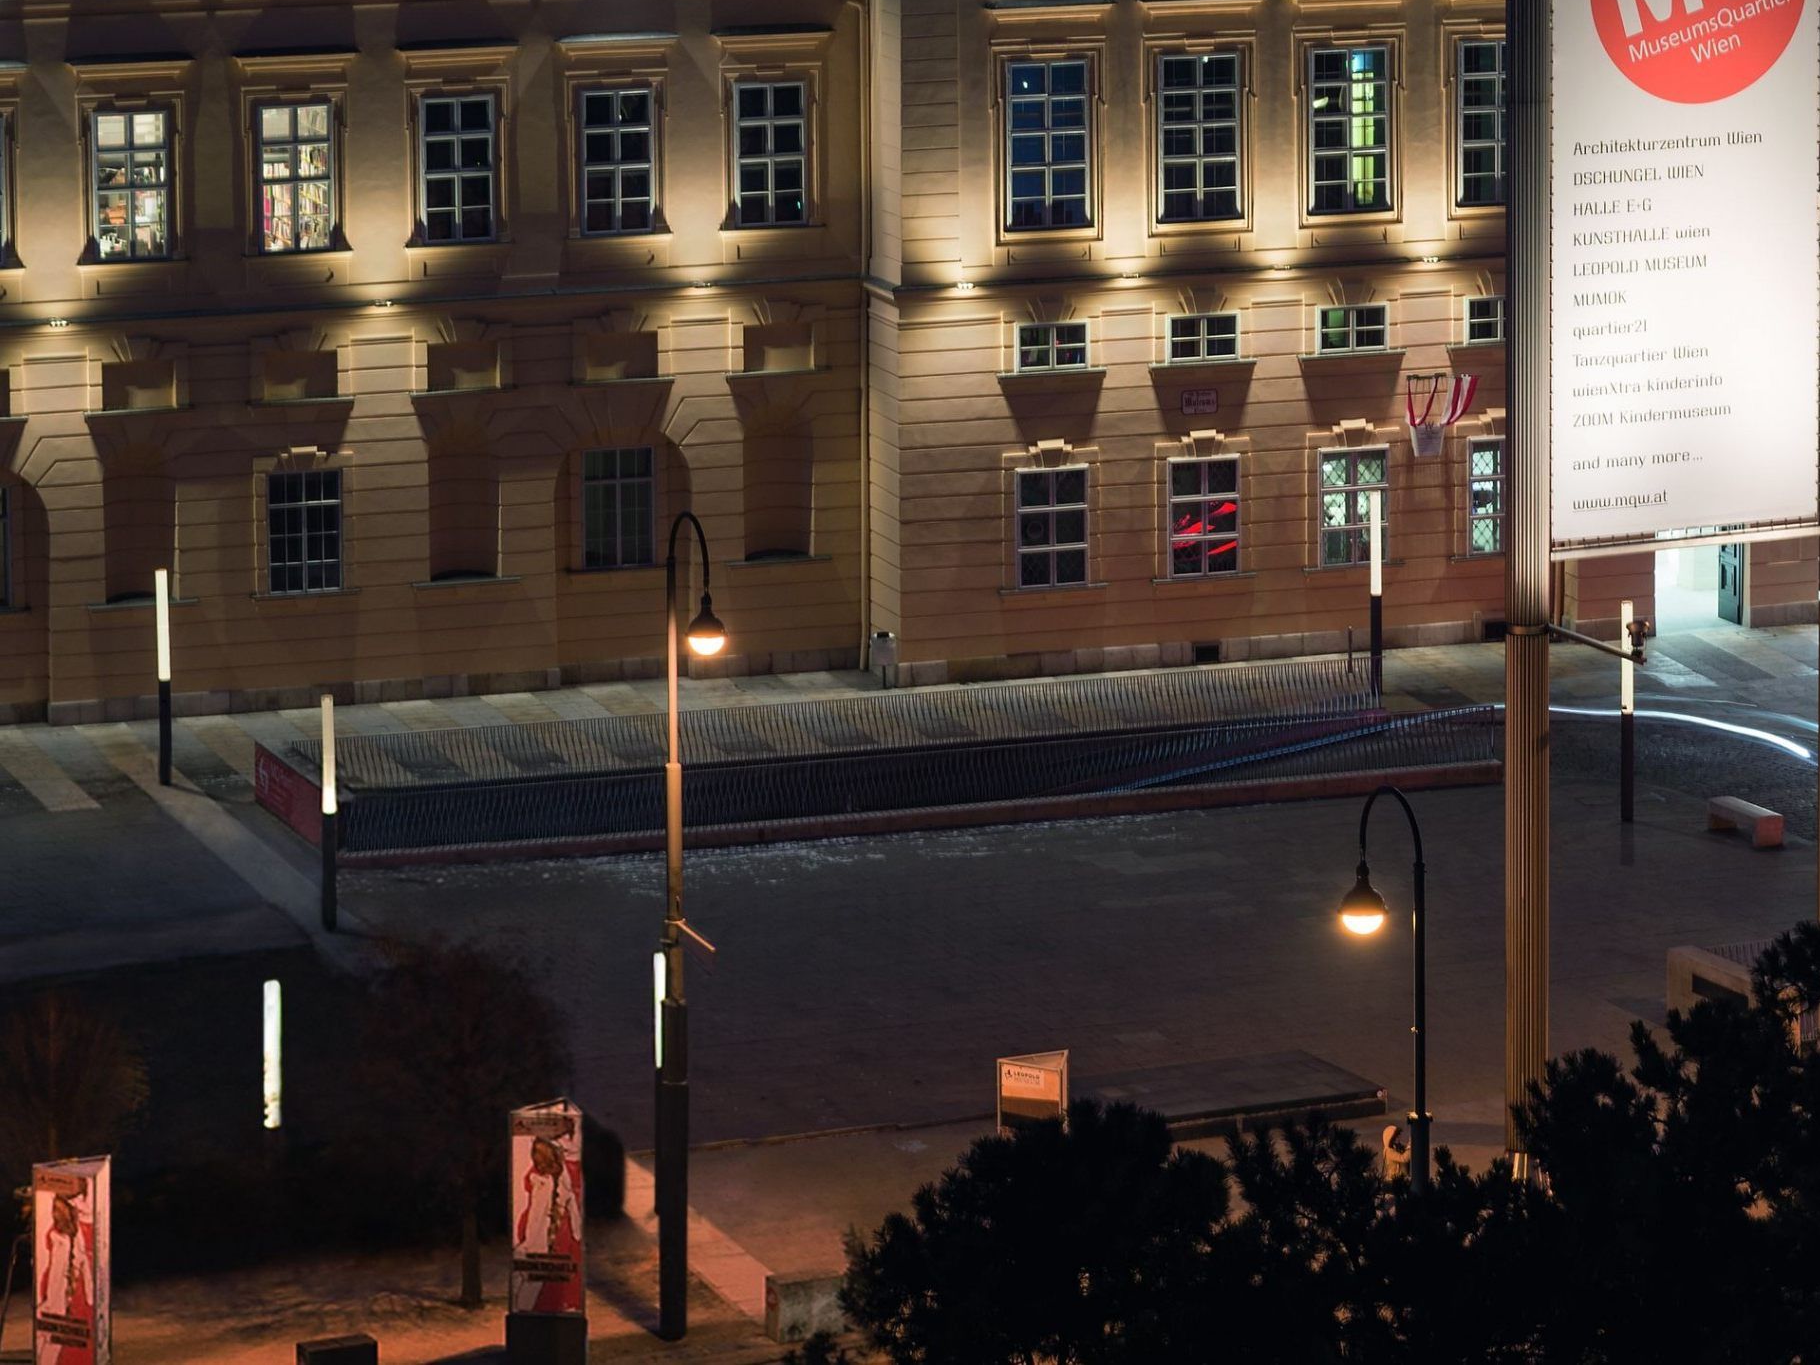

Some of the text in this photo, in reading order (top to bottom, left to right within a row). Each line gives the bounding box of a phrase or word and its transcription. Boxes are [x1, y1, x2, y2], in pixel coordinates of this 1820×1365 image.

[1690, 32, 1742, 65] Wien
[1573, 130, 1763, 156] Architekturzentrum Wien
[1573, 164, 1704, 186] DSCHUNGEL WIEN
[1573, 198, 1652, 217] HALLE E+G
[1573, 225, 1711, 247] KUNSTHALLE wien
[1573, 254, 1707, 277] LEOPOLD MUSEUM
[1573, 290, 1628, 307] MUMOK
[1573, 318, 1647, 340] quartier21
[1572, 345, 1710, 368] Tanzquartier Wien
[1572, 403, 1732, 428] ZOOM Kindermuseum
[1572, 456, 1601, 471] and
[1606, 455, 1647, 470] many
[1572, 489, 1669, 512] www.mqw.at
